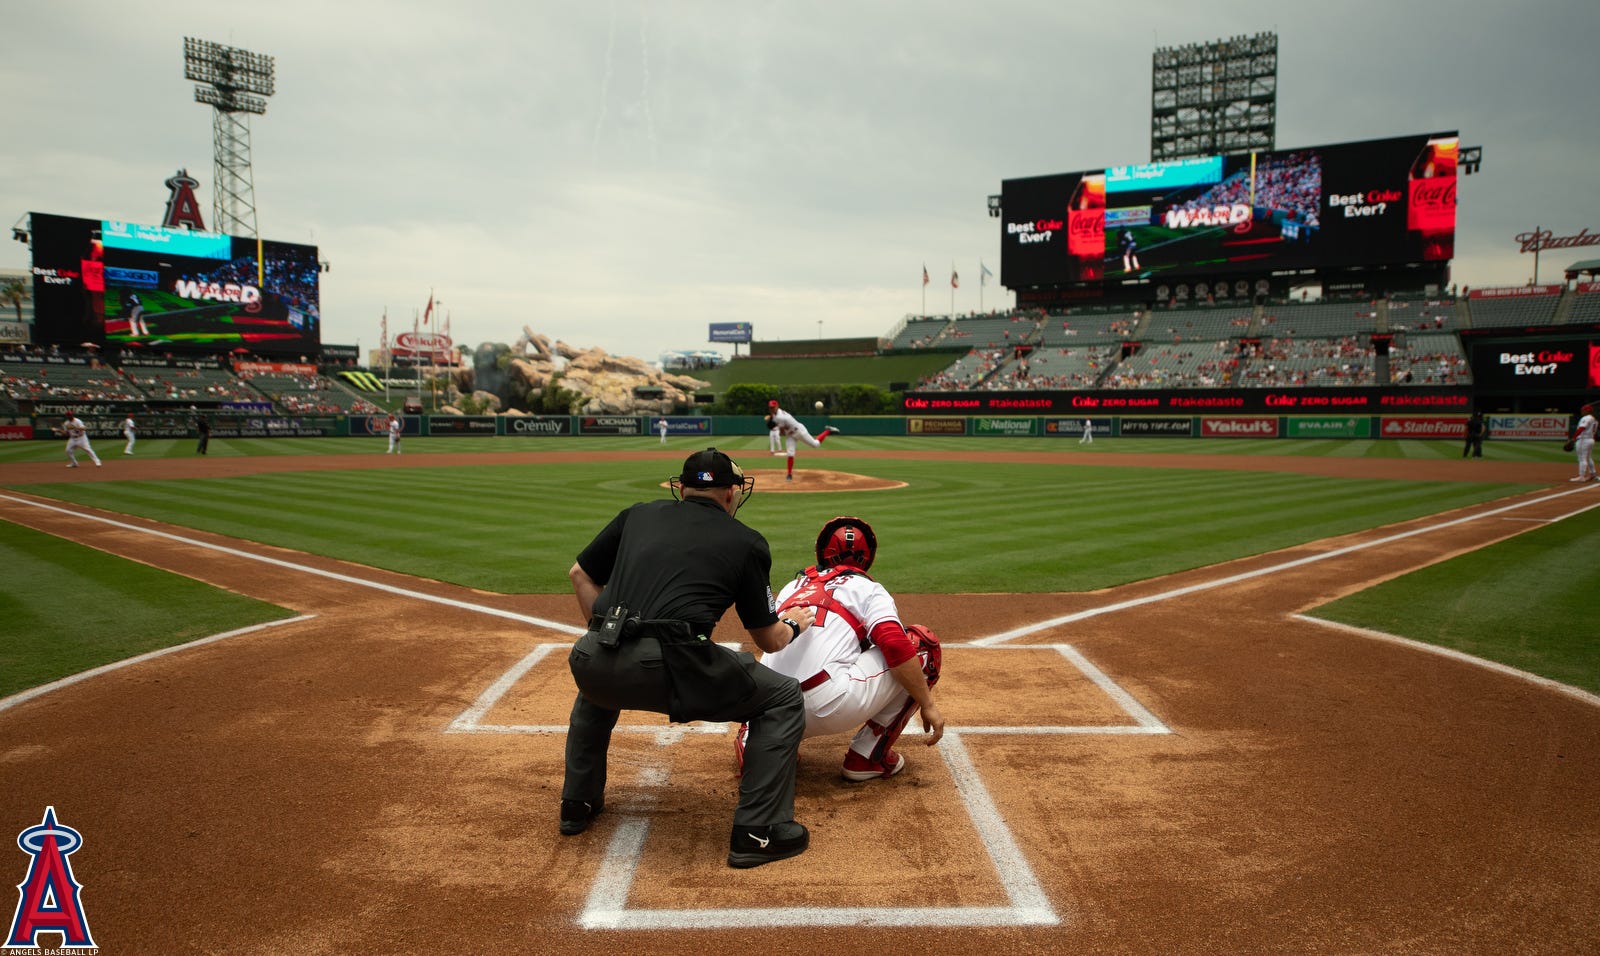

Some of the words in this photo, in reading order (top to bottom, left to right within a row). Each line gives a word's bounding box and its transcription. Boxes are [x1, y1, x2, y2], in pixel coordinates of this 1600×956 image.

[1329, 192, 1364, 207] Best
[1368, 189, 1402, 203] Coke
[1166, 204, 1250, 230] WARD
[1344, 203, 1387, 218] Ever?
[1008, 222, 1035, 234] Best
[1036, 219, 1063, 231] Coke
[1020, 230, 1052, 243] Ever?
[33, 267, 56, 277] Best
[104, 267, 157, 281] NEXGEN
[44, 276, 71, 285] Ever?
[176, 280, 260, 303] WARD
[1500, 352, 1535, 364] Best
[1538, 350, 1575, 363] Coke
[1515, 363, 1558, 375] Ever?
[905, 398, 929, 409] Coke
[931, 400, 952, 408] ZERO
[953, 400, 980, 408] SUGAR
[989, 399, 1052, 408] #takeataste
[1072, 396, 1099, 407] Coke
[1102, 398, 1126, 407] ZERO
[1128, 398, 1159, 407] SUGAR
[1169, 397, 1244, 407] #takeataste
[1265, 394, 1298, 407] Coke
[1301, 397, 1329, 406] ZERO
[1331, 396, 1368, 406] SUGAR
[1380, 395, 1468, 406] #takeataste
[597, 418, 637, 426] YOKOHAMA
[991, 419, 1032, 431] National
[1123, 421, 1149, 431] NITTO
[1206, 420, 1274, 433] Yakult
[1492, 417, 1566, 428] NEXGEN
